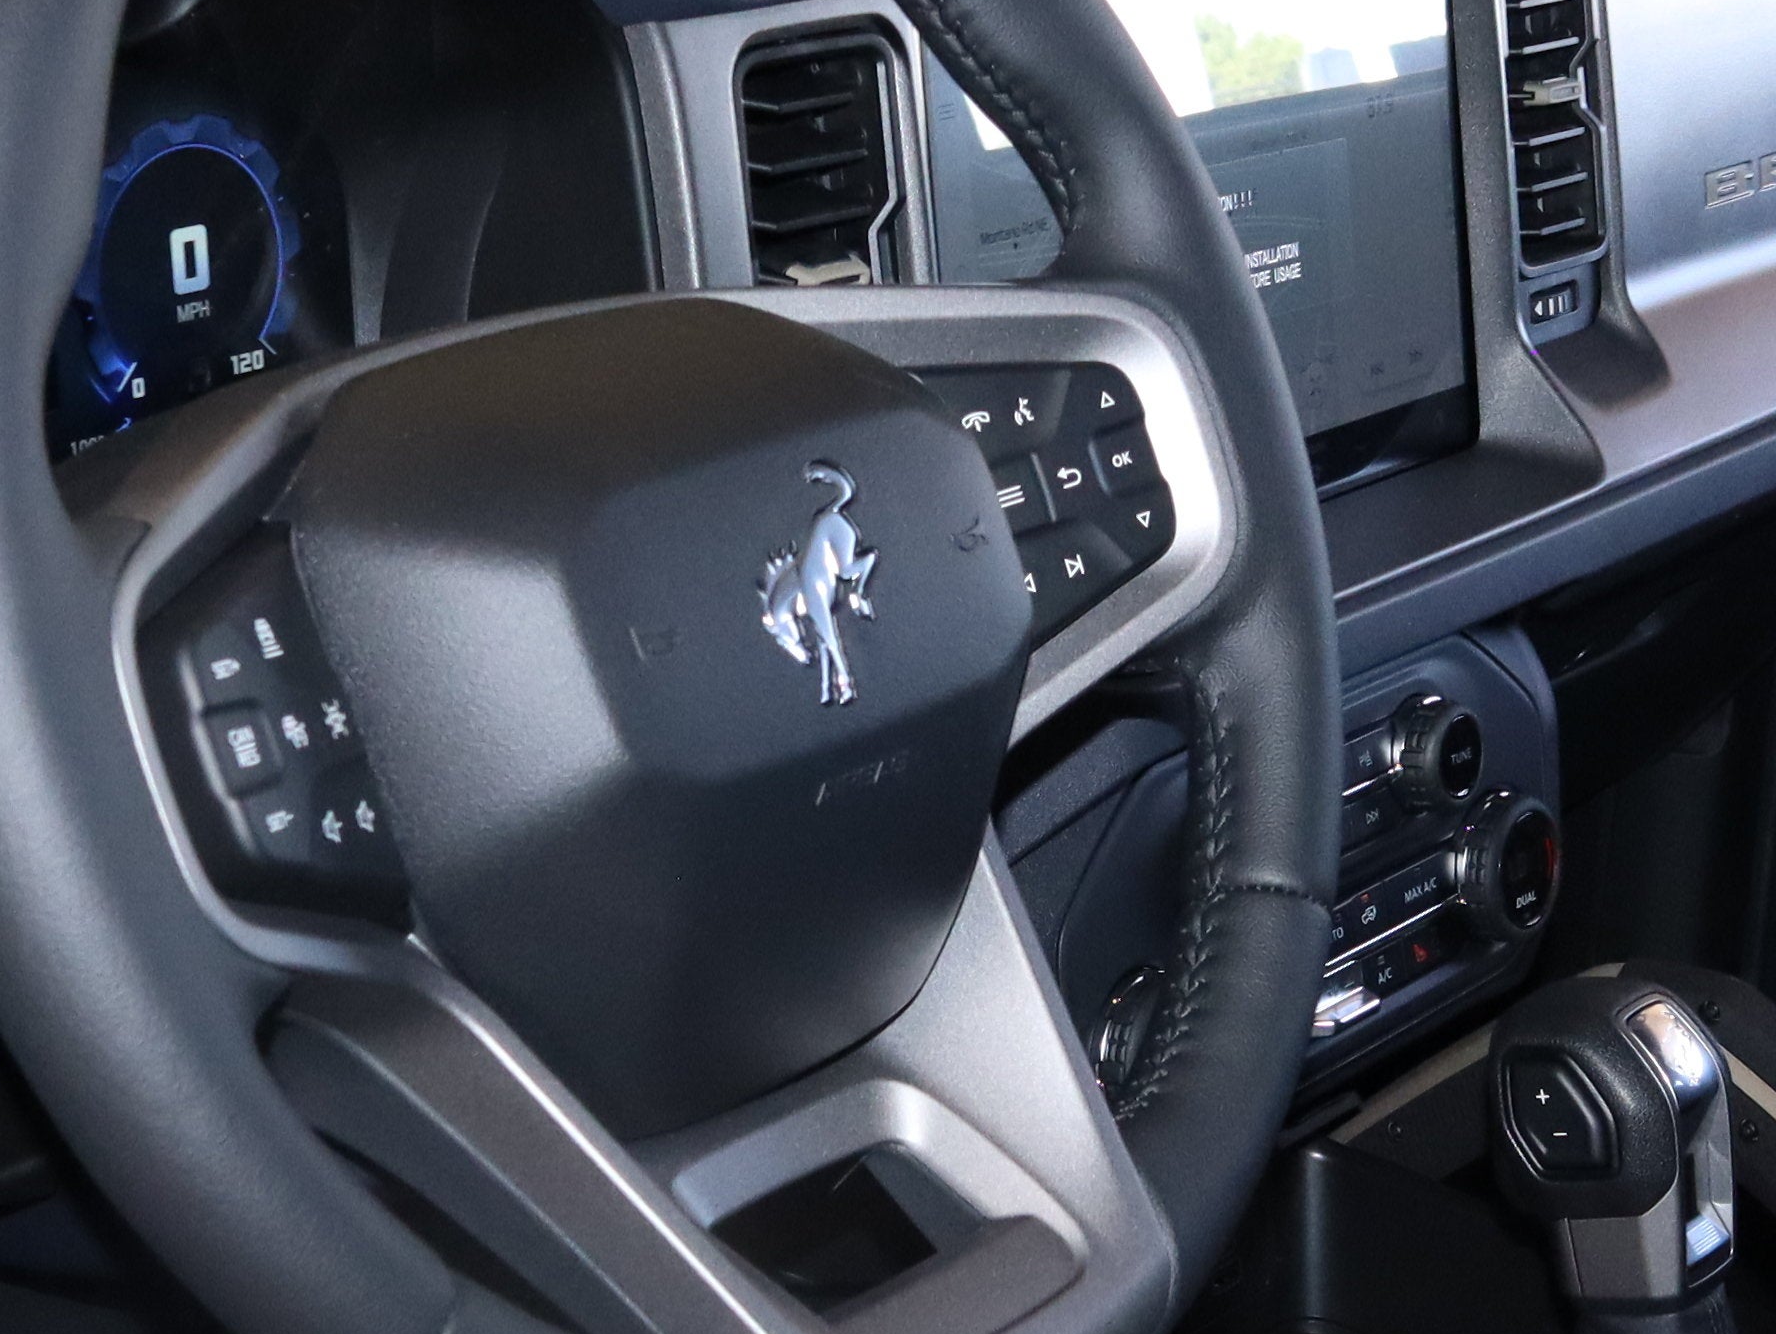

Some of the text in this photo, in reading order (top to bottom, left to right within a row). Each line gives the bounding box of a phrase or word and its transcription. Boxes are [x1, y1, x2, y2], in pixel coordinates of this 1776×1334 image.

[1217, 189, 1253, 212] ON!!!
[169, 223, 212, 296] 0
[1273, 262, 1302, 283] USAGE
[176, 299, 211, 323] MPH
[230, 349, 265, 376] 120
[131, 377, 146, 400] 0
[1111, 450, 1134, 468] OK
[1450, 746, 1473, 766] TUNE
[1403, 876, 1437, 904] MAX A/C
[1515, 889, 1537, 910] DUAL
[1331, 926, 1345, 941] TO
[1377, 966, 1393, 985] A/C
